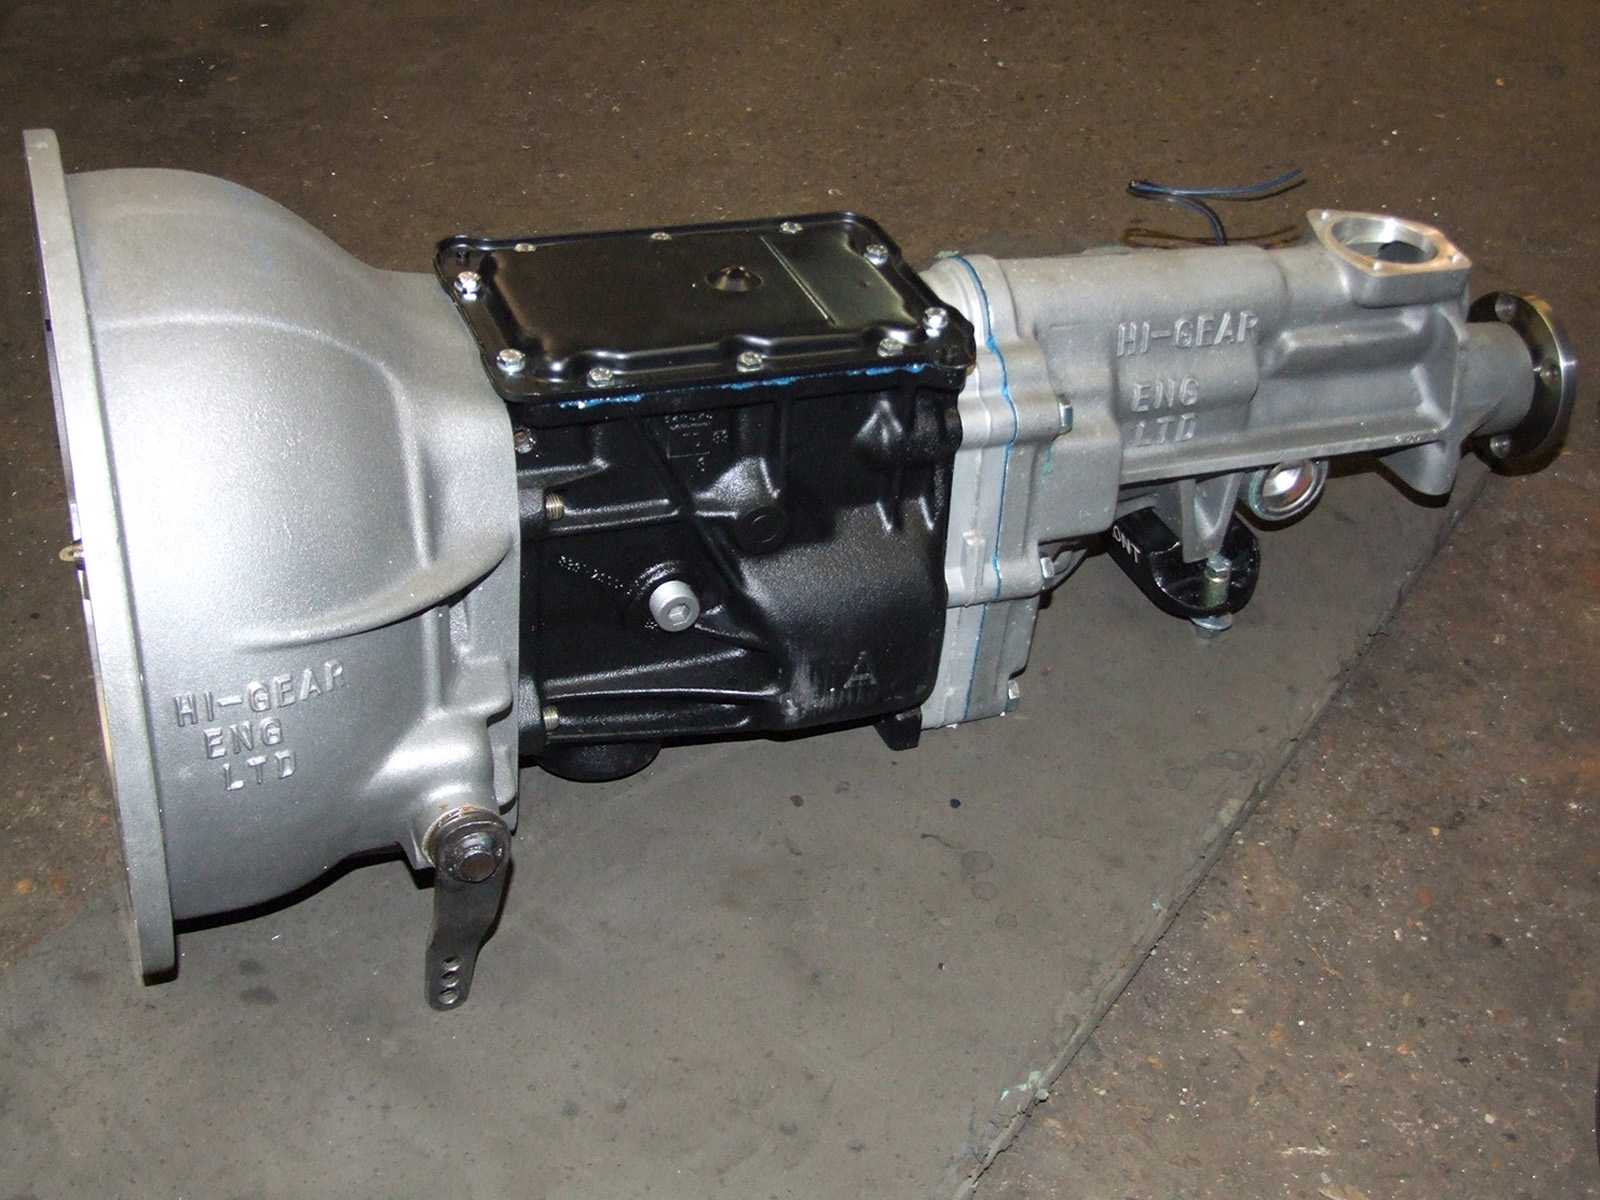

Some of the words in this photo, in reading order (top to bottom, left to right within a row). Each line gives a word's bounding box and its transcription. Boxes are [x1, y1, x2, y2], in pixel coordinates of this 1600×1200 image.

[1116, 311, 1258, 356] HI-GEAR
[1132, 376, 1199, 412] ENG
[1135, 412, 1197, 447] LTD
[173, 659, 345, 727] HI-GEAR
[203, 716, 283, 760] ENG
[223, 749, 296, 791] LTD
